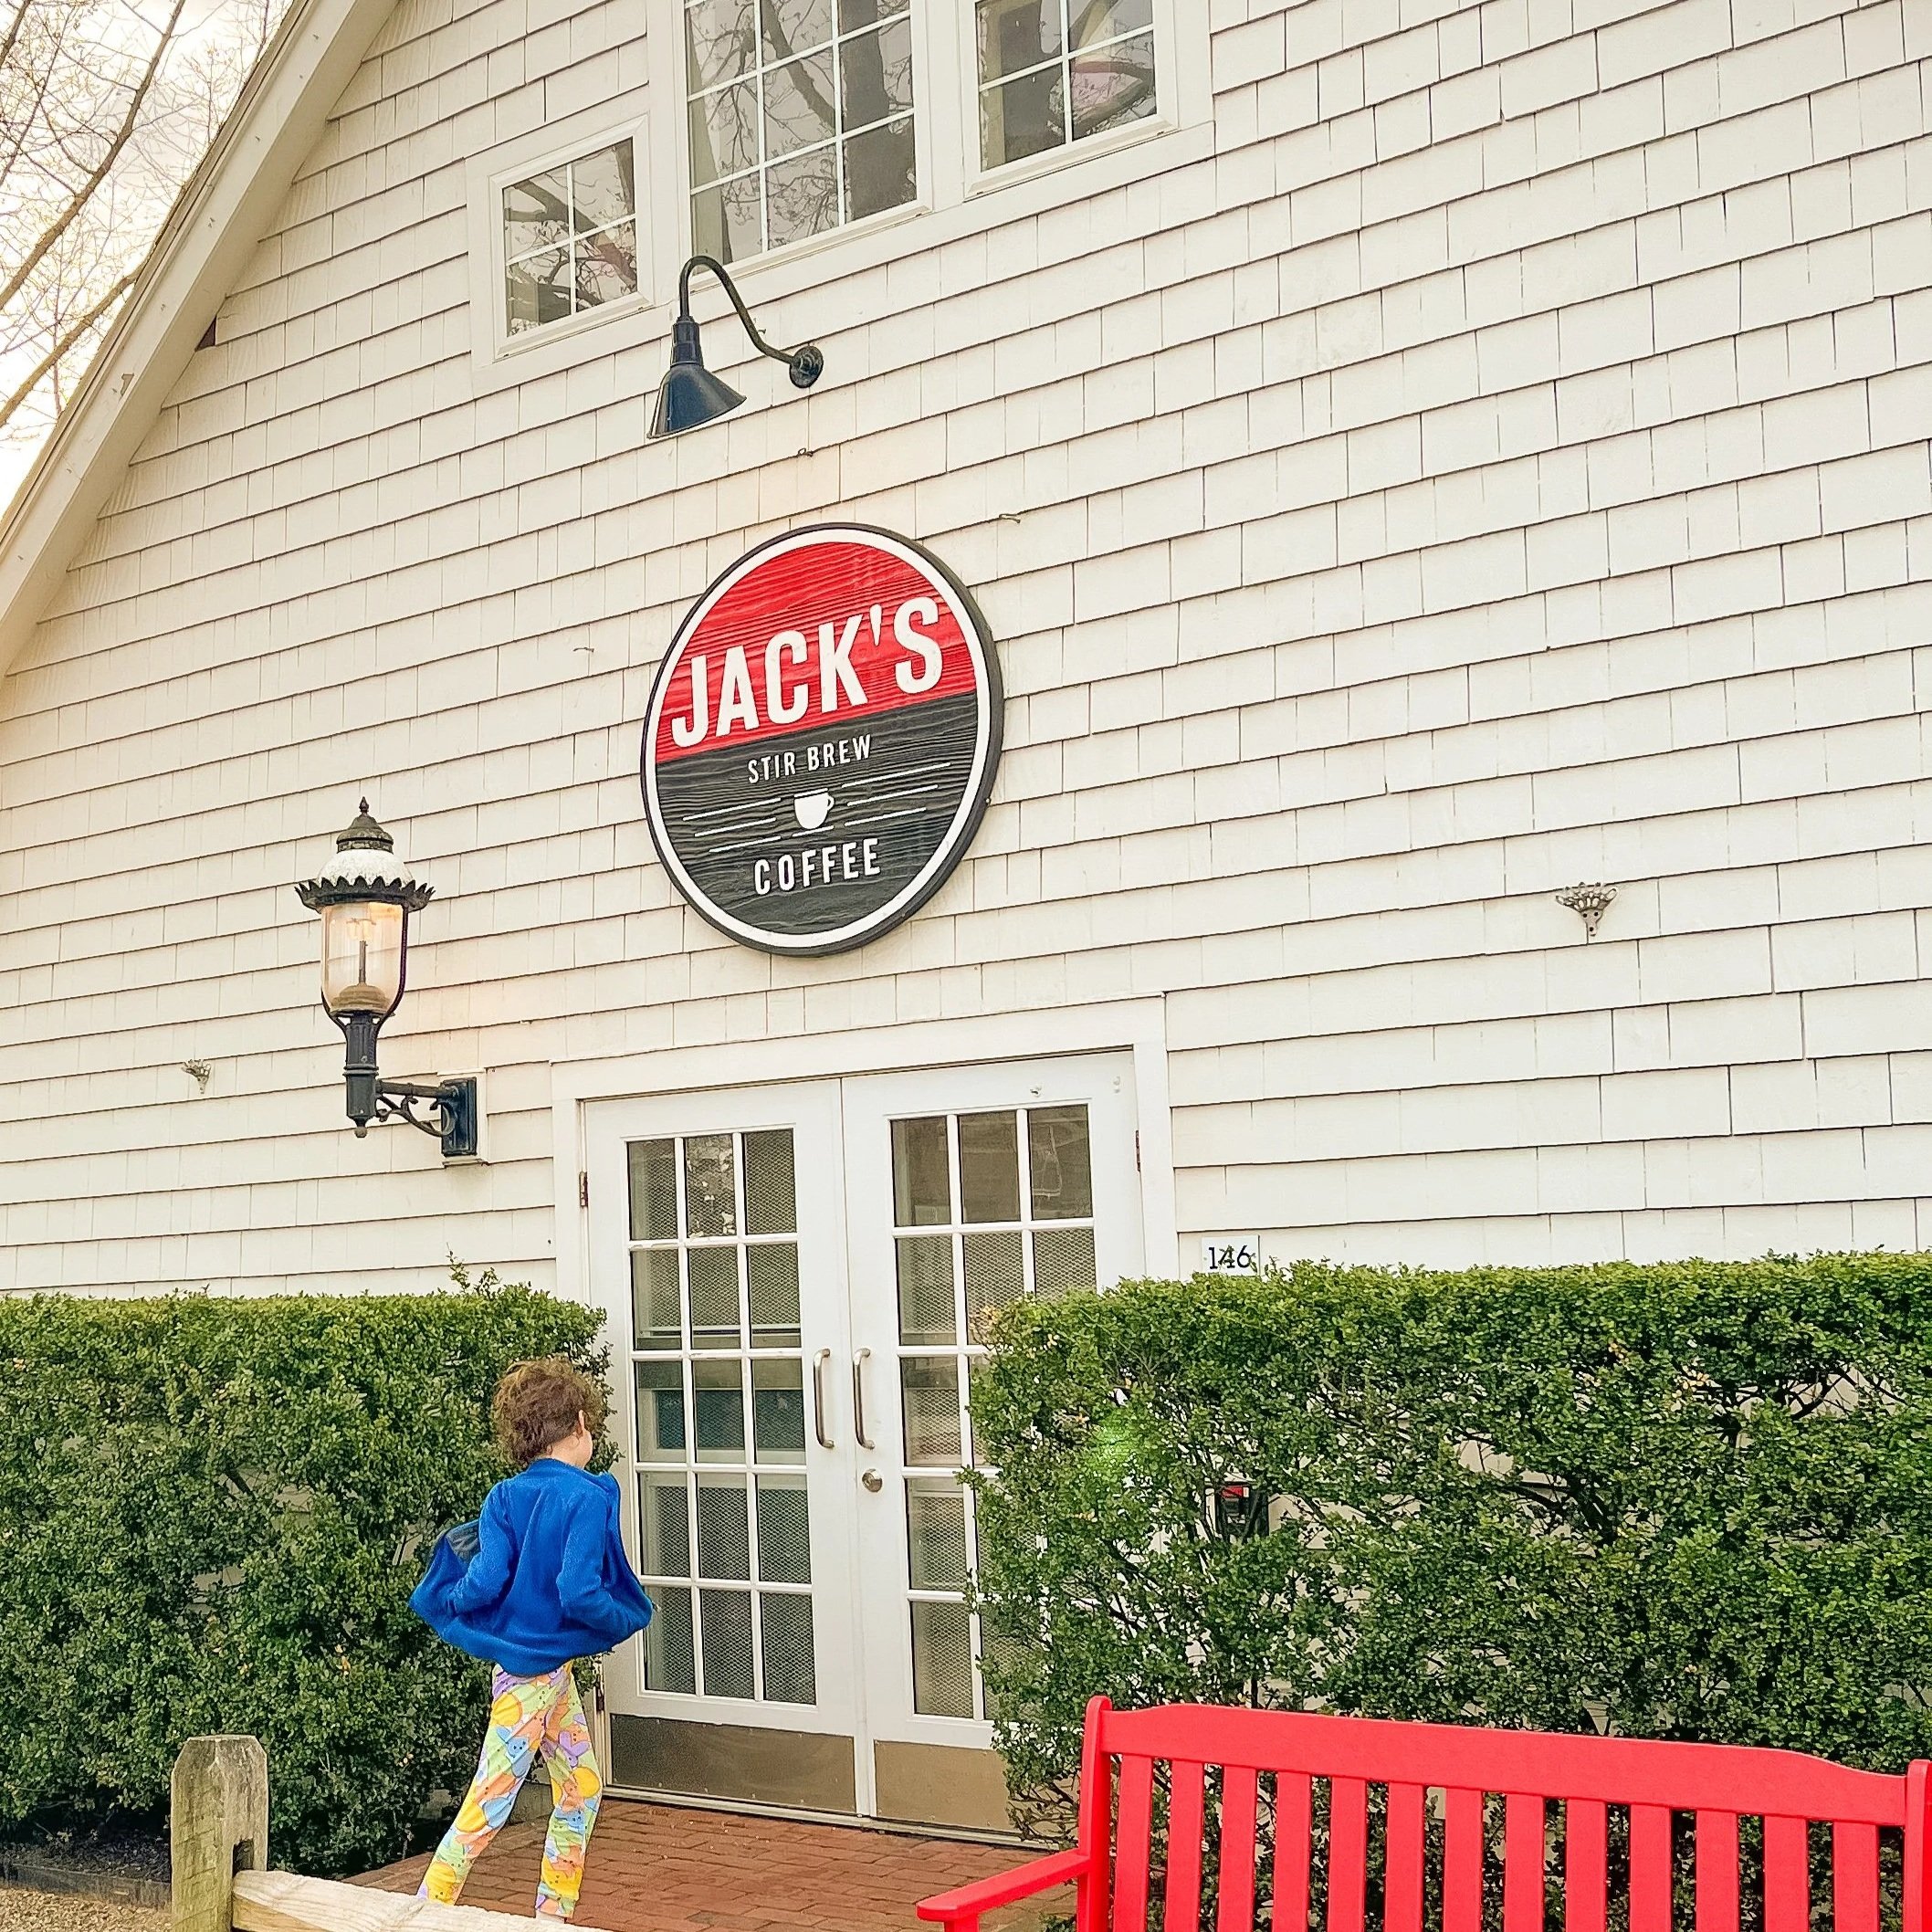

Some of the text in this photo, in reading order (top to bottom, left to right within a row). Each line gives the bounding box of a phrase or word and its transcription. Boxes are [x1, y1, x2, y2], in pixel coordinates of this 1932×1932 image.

[671, 596, 943, 748] JACK'S
[747, 734, 872, 784] STIR BREW
[753, 837, 881, 896] COFFEE
[1208, 1244, 1252, 1270] 146
